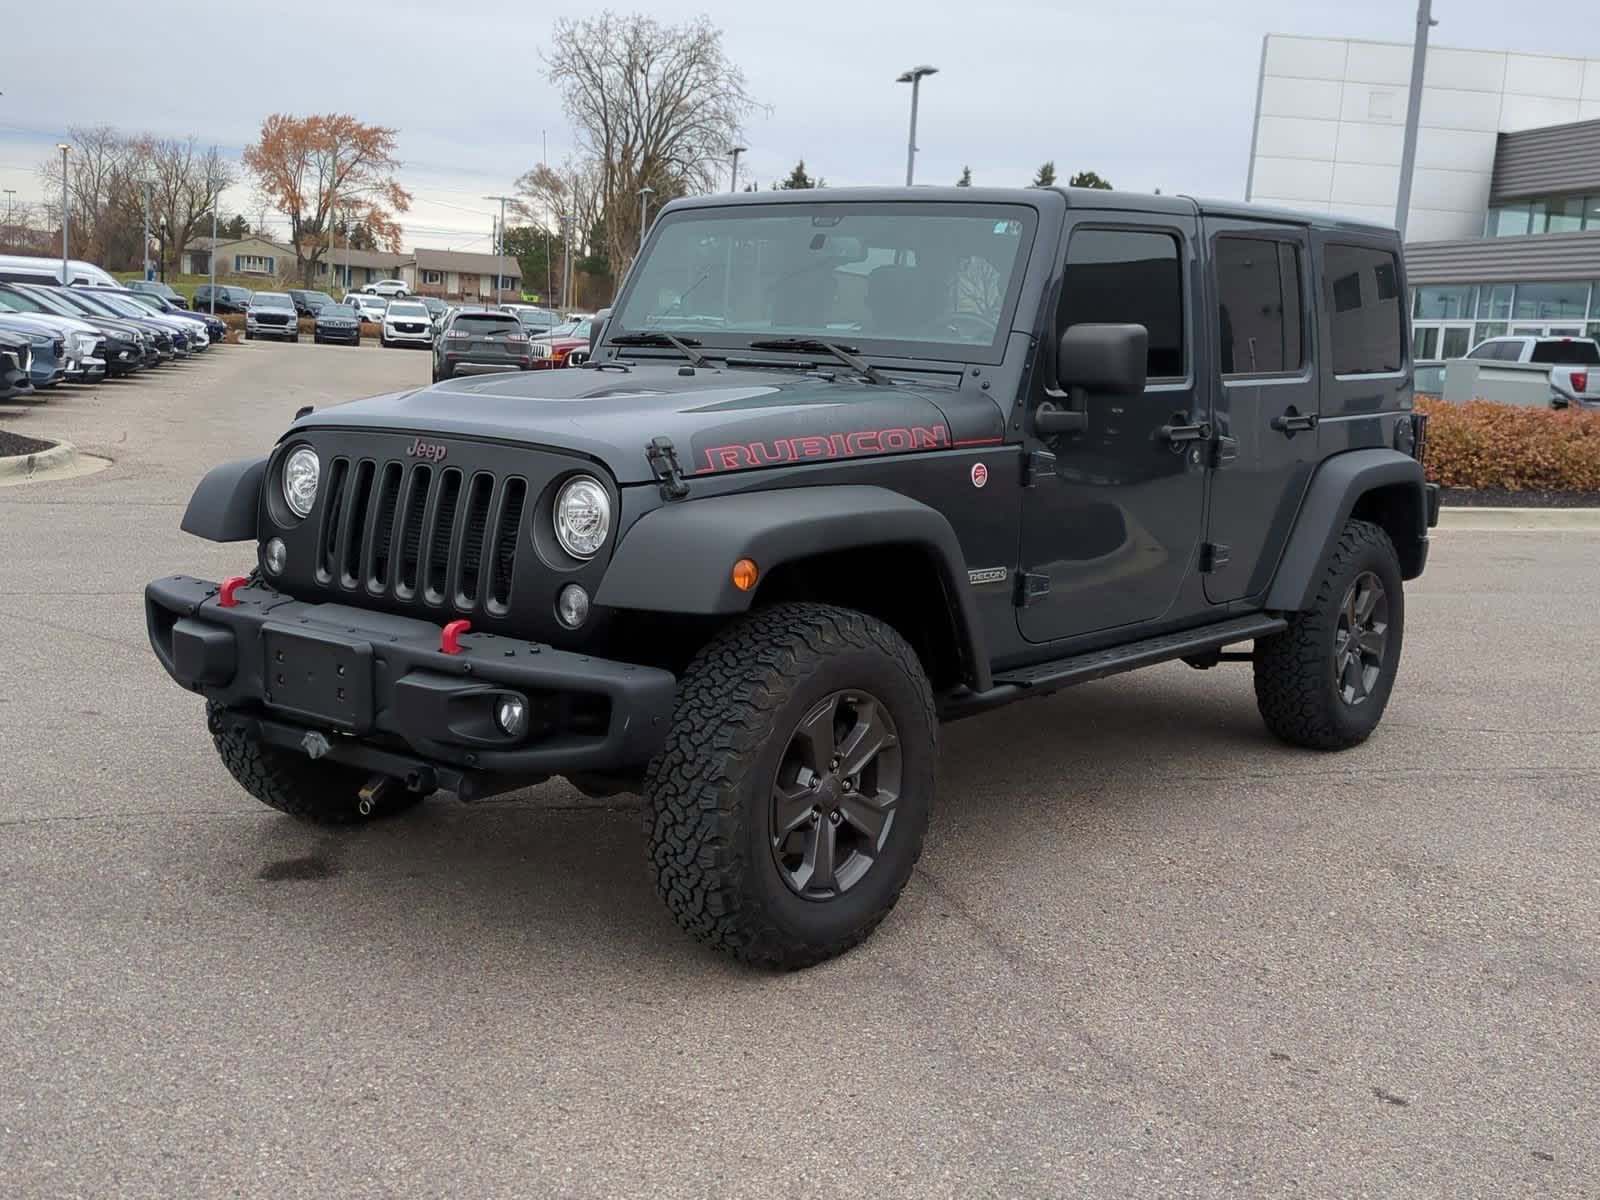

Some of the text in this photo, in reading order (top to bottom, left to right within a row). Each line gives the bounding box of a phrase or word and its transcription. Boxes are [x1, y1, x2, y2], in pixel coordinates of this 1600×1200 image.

[406, 438, 447, 463] Jeep
[696, 425, 950, 474] RUBICON
[969, 569, 1004, 582] RECON
